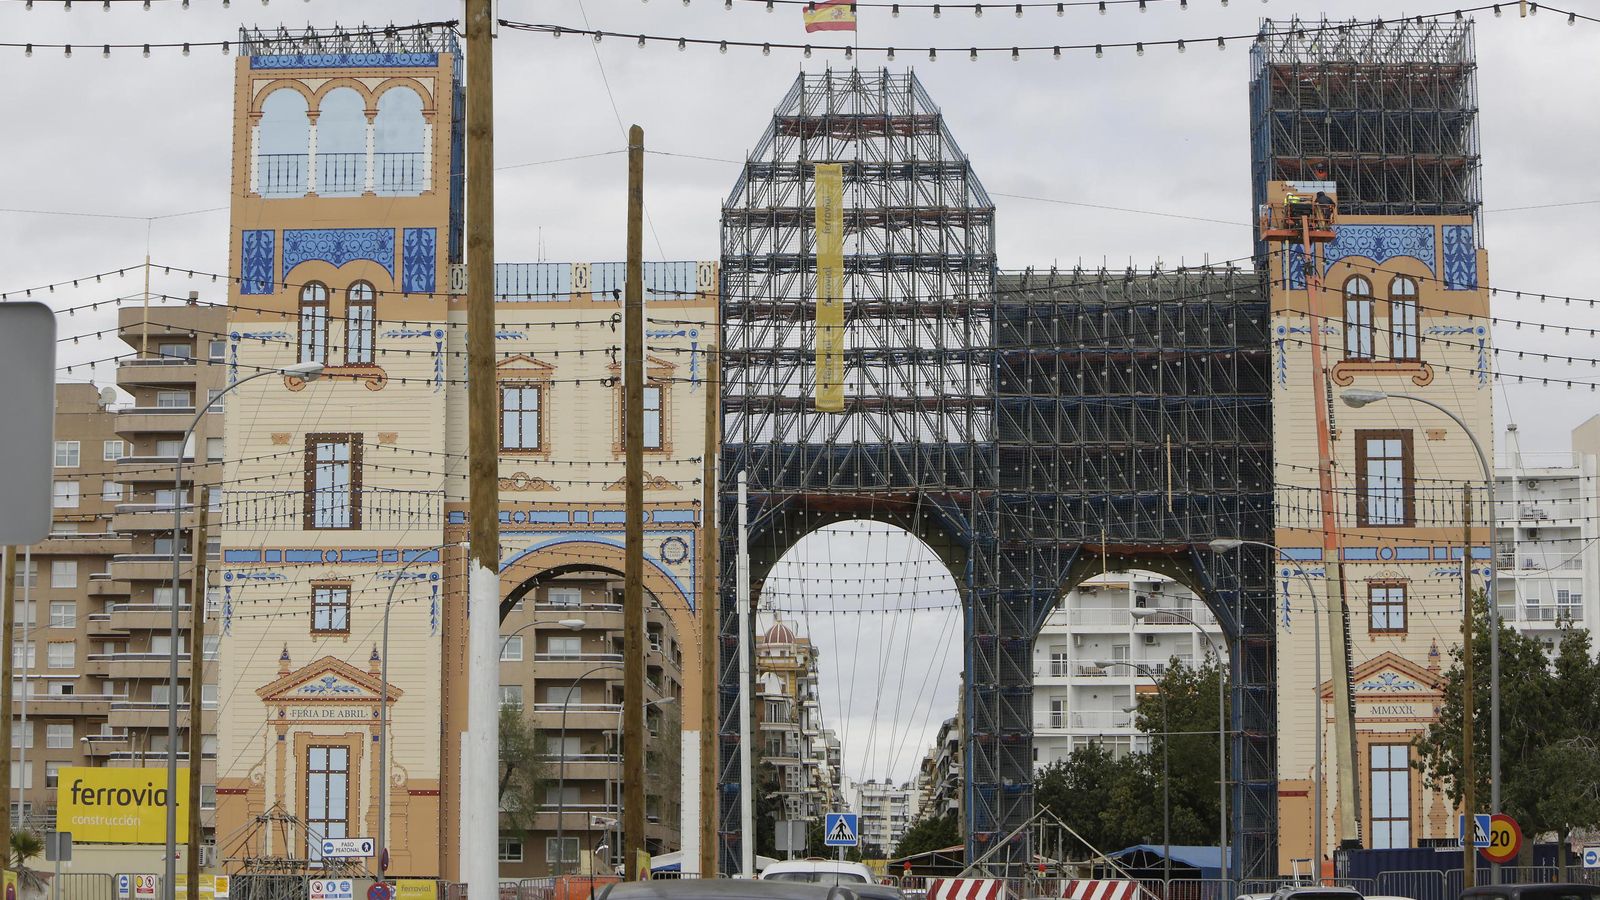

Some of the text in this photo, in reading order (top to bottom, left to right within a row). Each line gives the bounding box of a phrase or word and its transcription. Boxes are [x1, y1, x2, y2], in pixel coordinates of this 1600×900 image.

[322, 709, 335, 718] DE
[71, 779, 179, 807] ferrovia
[71, 814, 141, 827] construcción
[1491, 830, 1510, 847] 20
